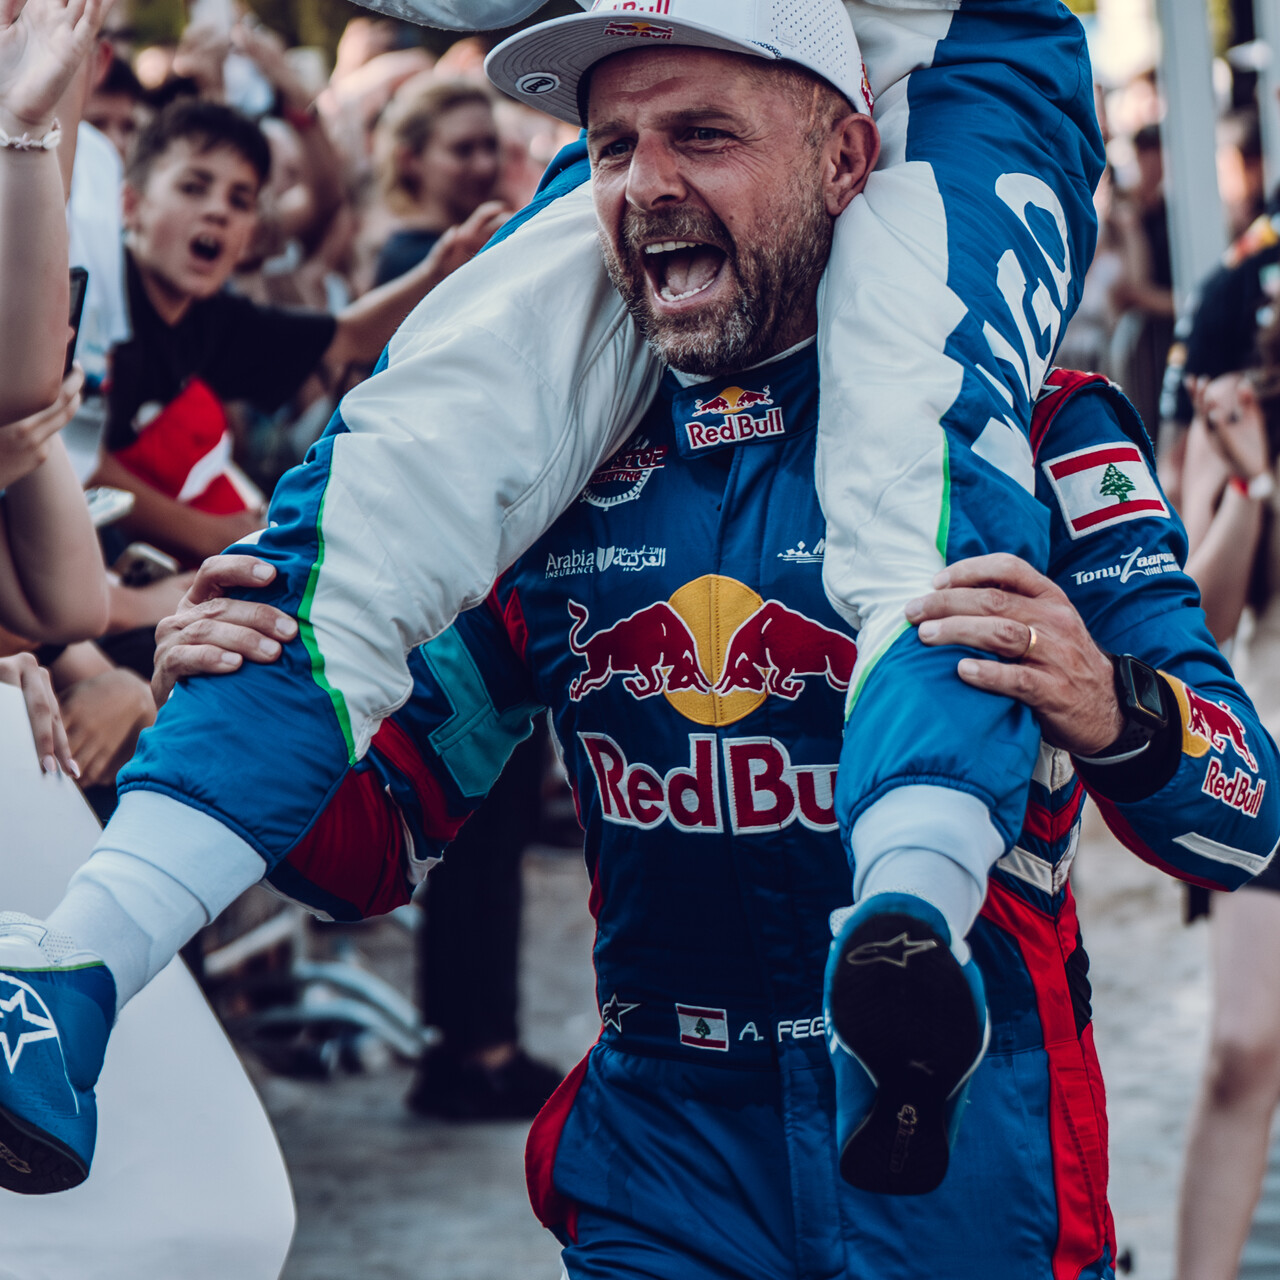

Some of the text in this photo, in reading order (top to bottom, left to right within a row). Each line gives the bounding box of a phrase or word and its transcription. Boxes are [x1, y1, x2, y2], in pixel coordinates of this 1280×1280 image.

[685, 407, 785, 450] Red Bull
[546, 549, 595, 571] Arabia
[545, 565, 594, 579] INSURANCE
[1071, 565, 1121, 585] Tony
[577, 731, 724, 833] Red
[1201, 756, 1267, 818] Red Bull
[739, 1021, 764, 1041] A.
